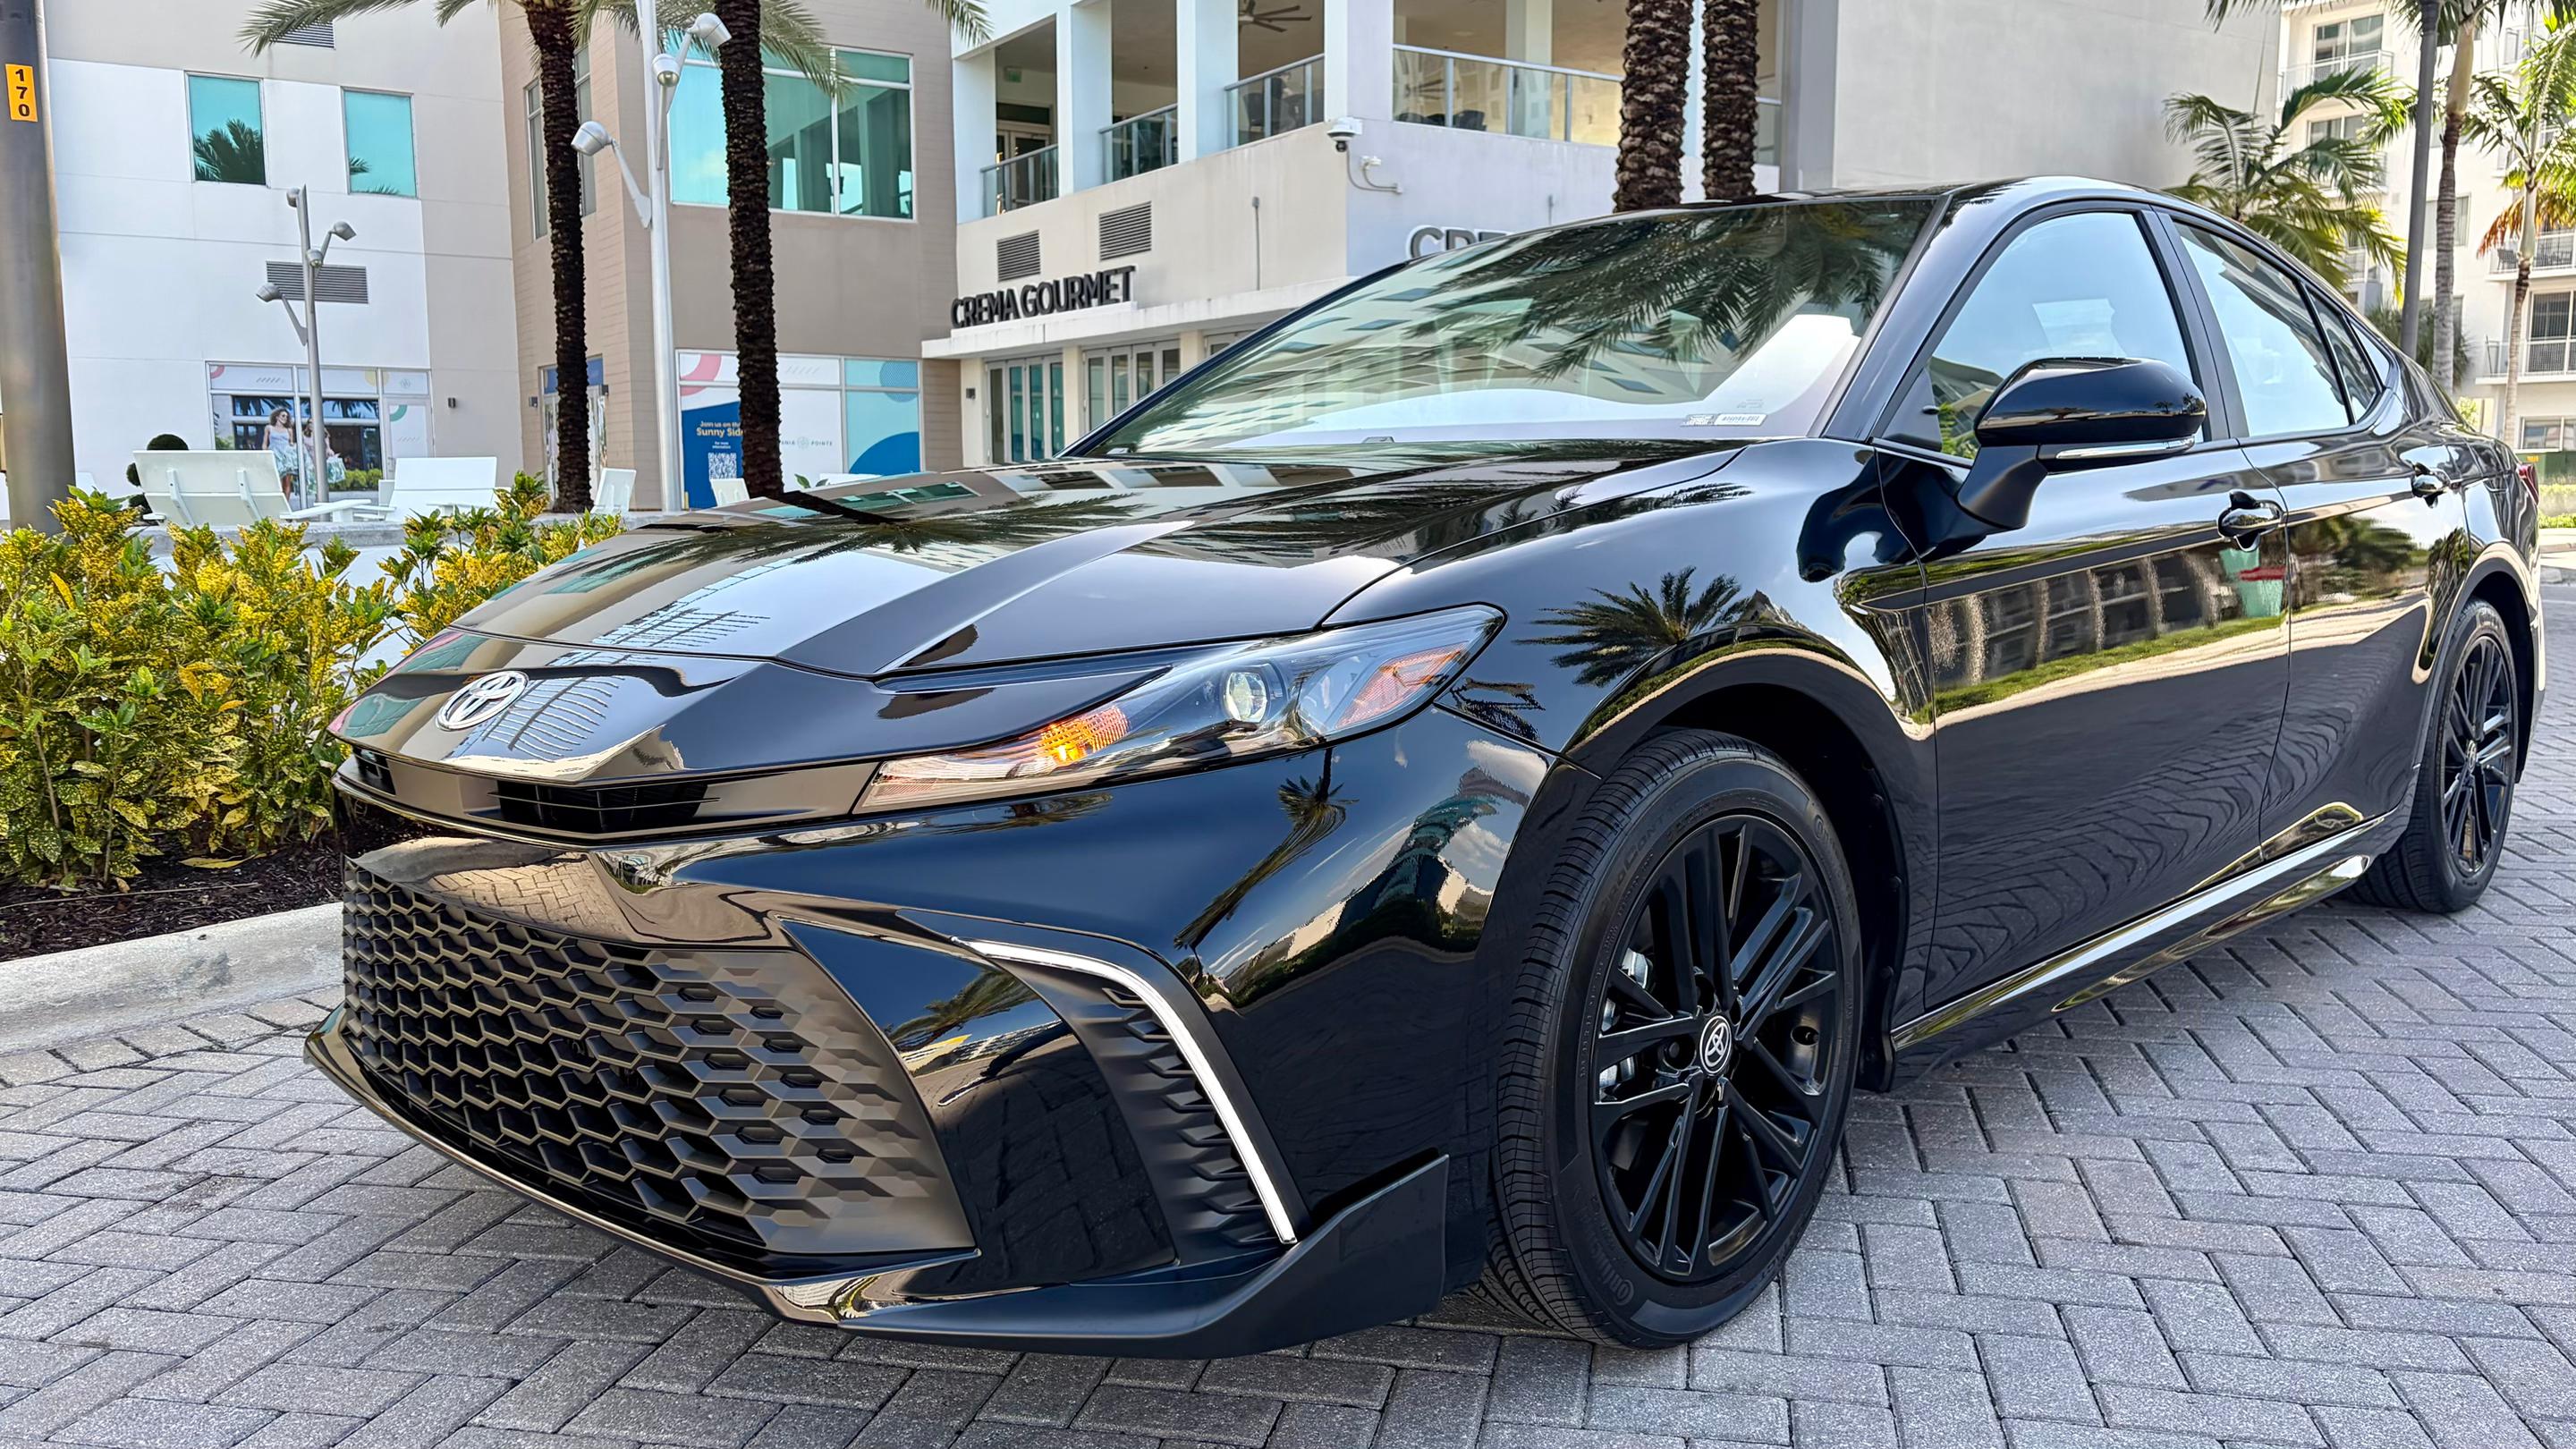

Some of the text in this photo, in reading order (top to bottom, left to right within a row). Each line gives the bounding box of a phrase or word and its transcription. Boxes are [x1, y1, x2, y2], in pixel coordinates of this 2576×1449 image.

[15, 69, 30, 116] 170
[951, 266, 1136, 328] CREMA GOURMET
[696, 428, 725, 438] Sunny
